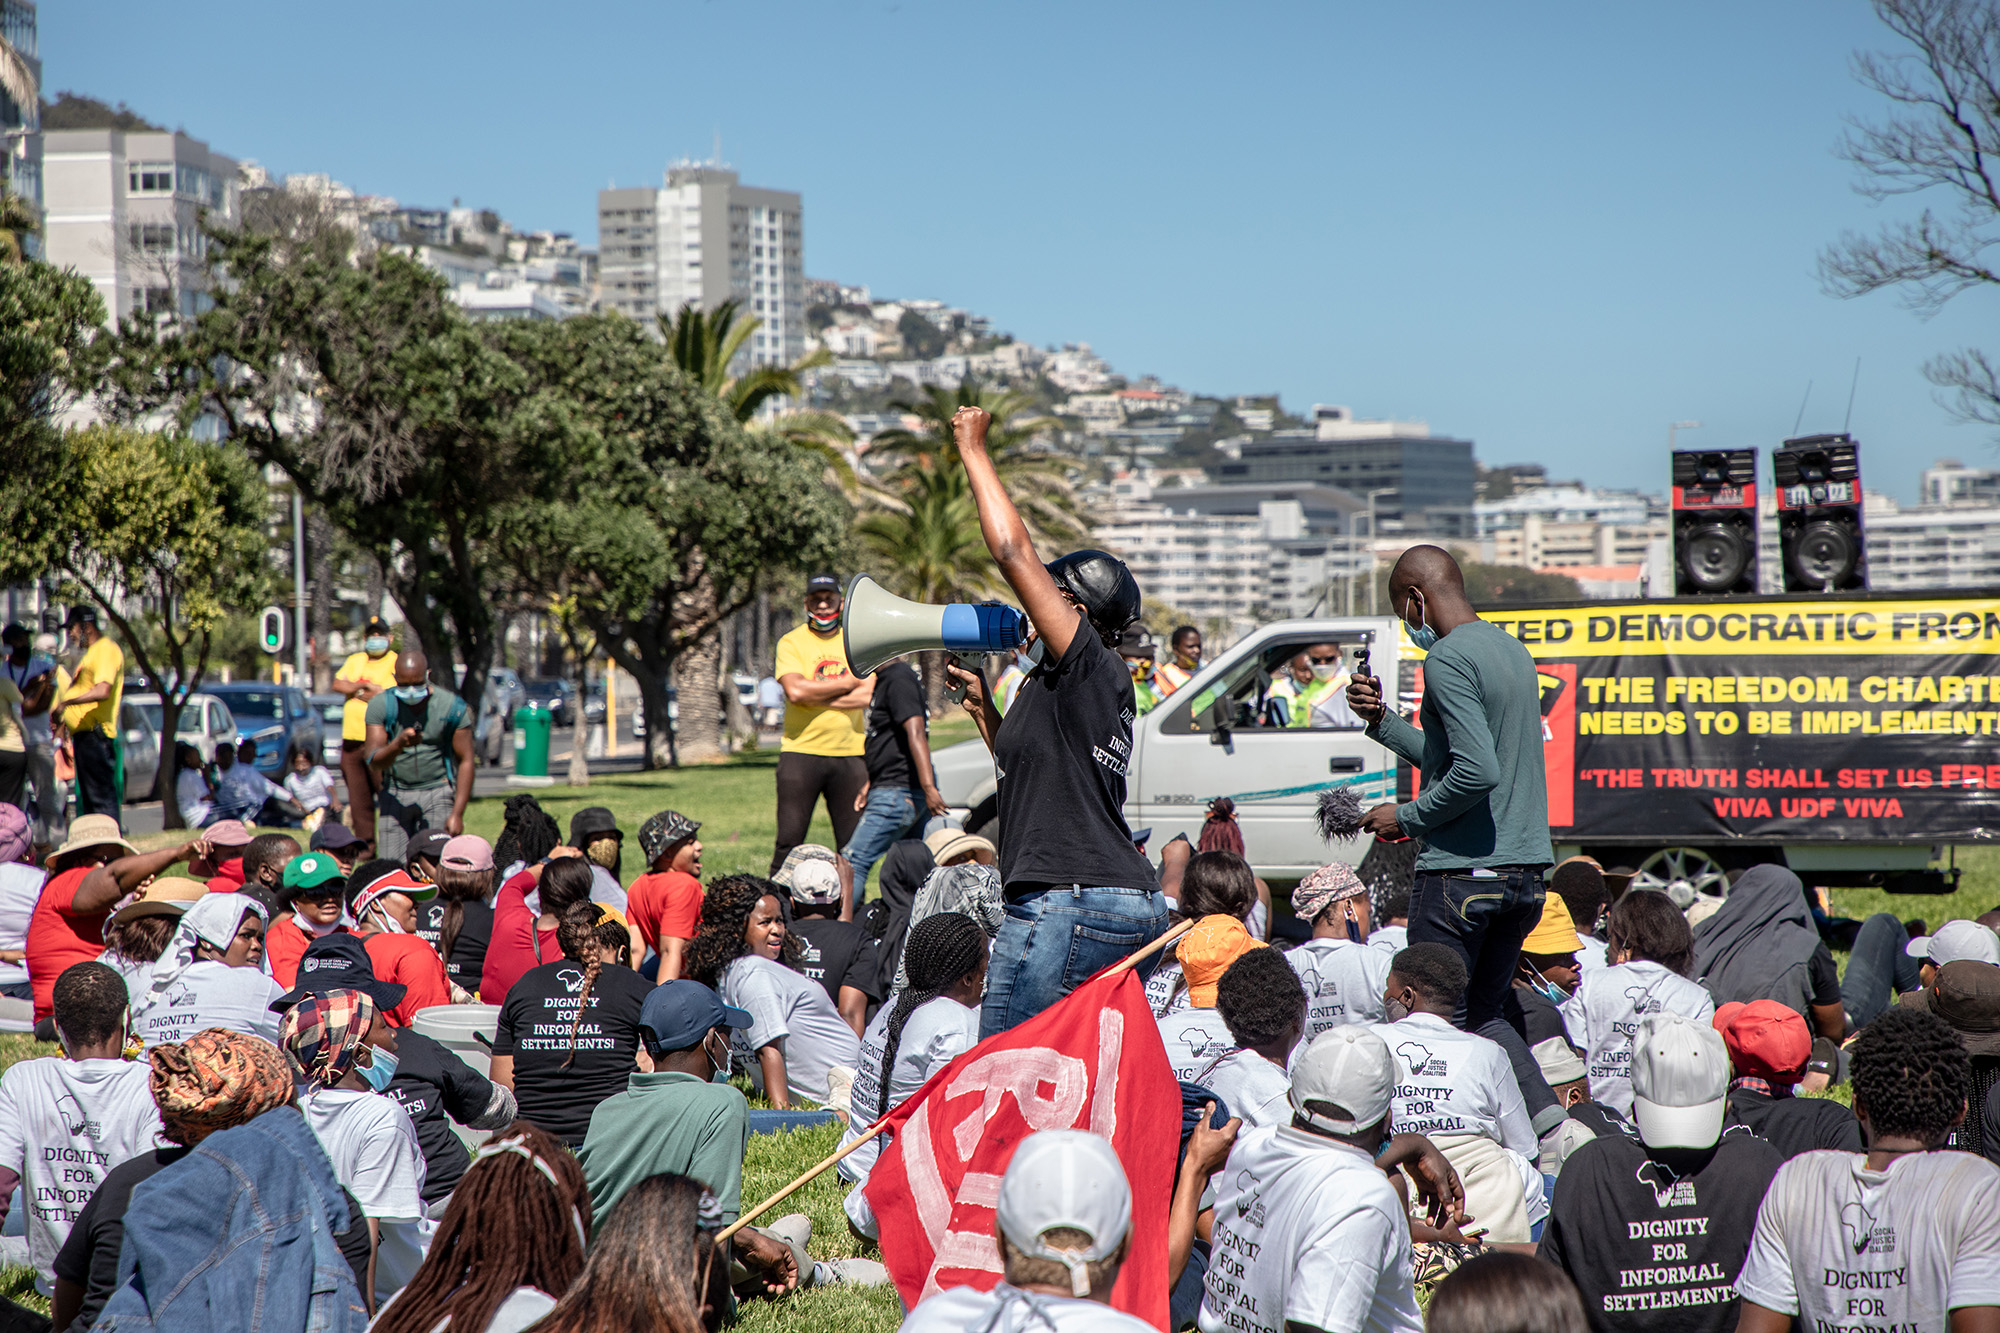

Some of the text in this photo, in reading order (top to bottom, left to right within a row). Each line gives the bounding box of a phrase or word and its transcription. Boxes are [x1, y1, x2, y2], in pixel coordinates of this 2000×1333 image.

[1491, 617, 1574, 644] TED
[1588, 612, 1878, 643] DEMOCRATIC
[1582, 677, 1654, 704] THE
[1666, 676, 1848, 703] FREEDOM
[1580, 711, 2000, 735] NEEDS TO BE IMPLEMENT
[1651, 769, 1738, 788] TRUTH
[1745, 769, 1829, 788] SHALL
[1837, 769, 1888, 788] SET
[1897, 769, 1932, 788] US
[1713, 798, 1903, 818] VIVA UDF VIVA
[1147, 980, 1167, 993] OR
[1307, 1004, 1345, 1019] IGNITY
[149, 1014, 199, 1029] DIGNITY
[159, 1030, 181, 1042] FOR
[1602, 1051, 1631, 1062] INFO
[1591, 1066, 1630, 1078] SETTLE
[1405, 1100, 1435, 1116] FOR
[1390, 1117, 1465, 1134] NFORMAL
[44, 1147, 110, 1167] DIGNITY
[64, 1169, 95, 1184] FOR
[1675, 1190, 1695, 1198] JUSTICE
[1676, 1182, 1694, 1190] SOCIAL
[37, 1187, 94, 1204] INFOR
[1670, 1198, 1697, 1207] COALITION
[31, 1203, 80, 1222] SETTLE
[1627, 1217, 1709, 1239] DIGNITY
[1652, 1243, 1688, 1261] FOR
[1219, 1252, 1245, 1280] FOR
[1620, 1263, 1725, 1287] INFORMAL
[1823, 1267, 1906, 1290] DIGNITY
[1846, 1298, 1887, 1317] FOR
